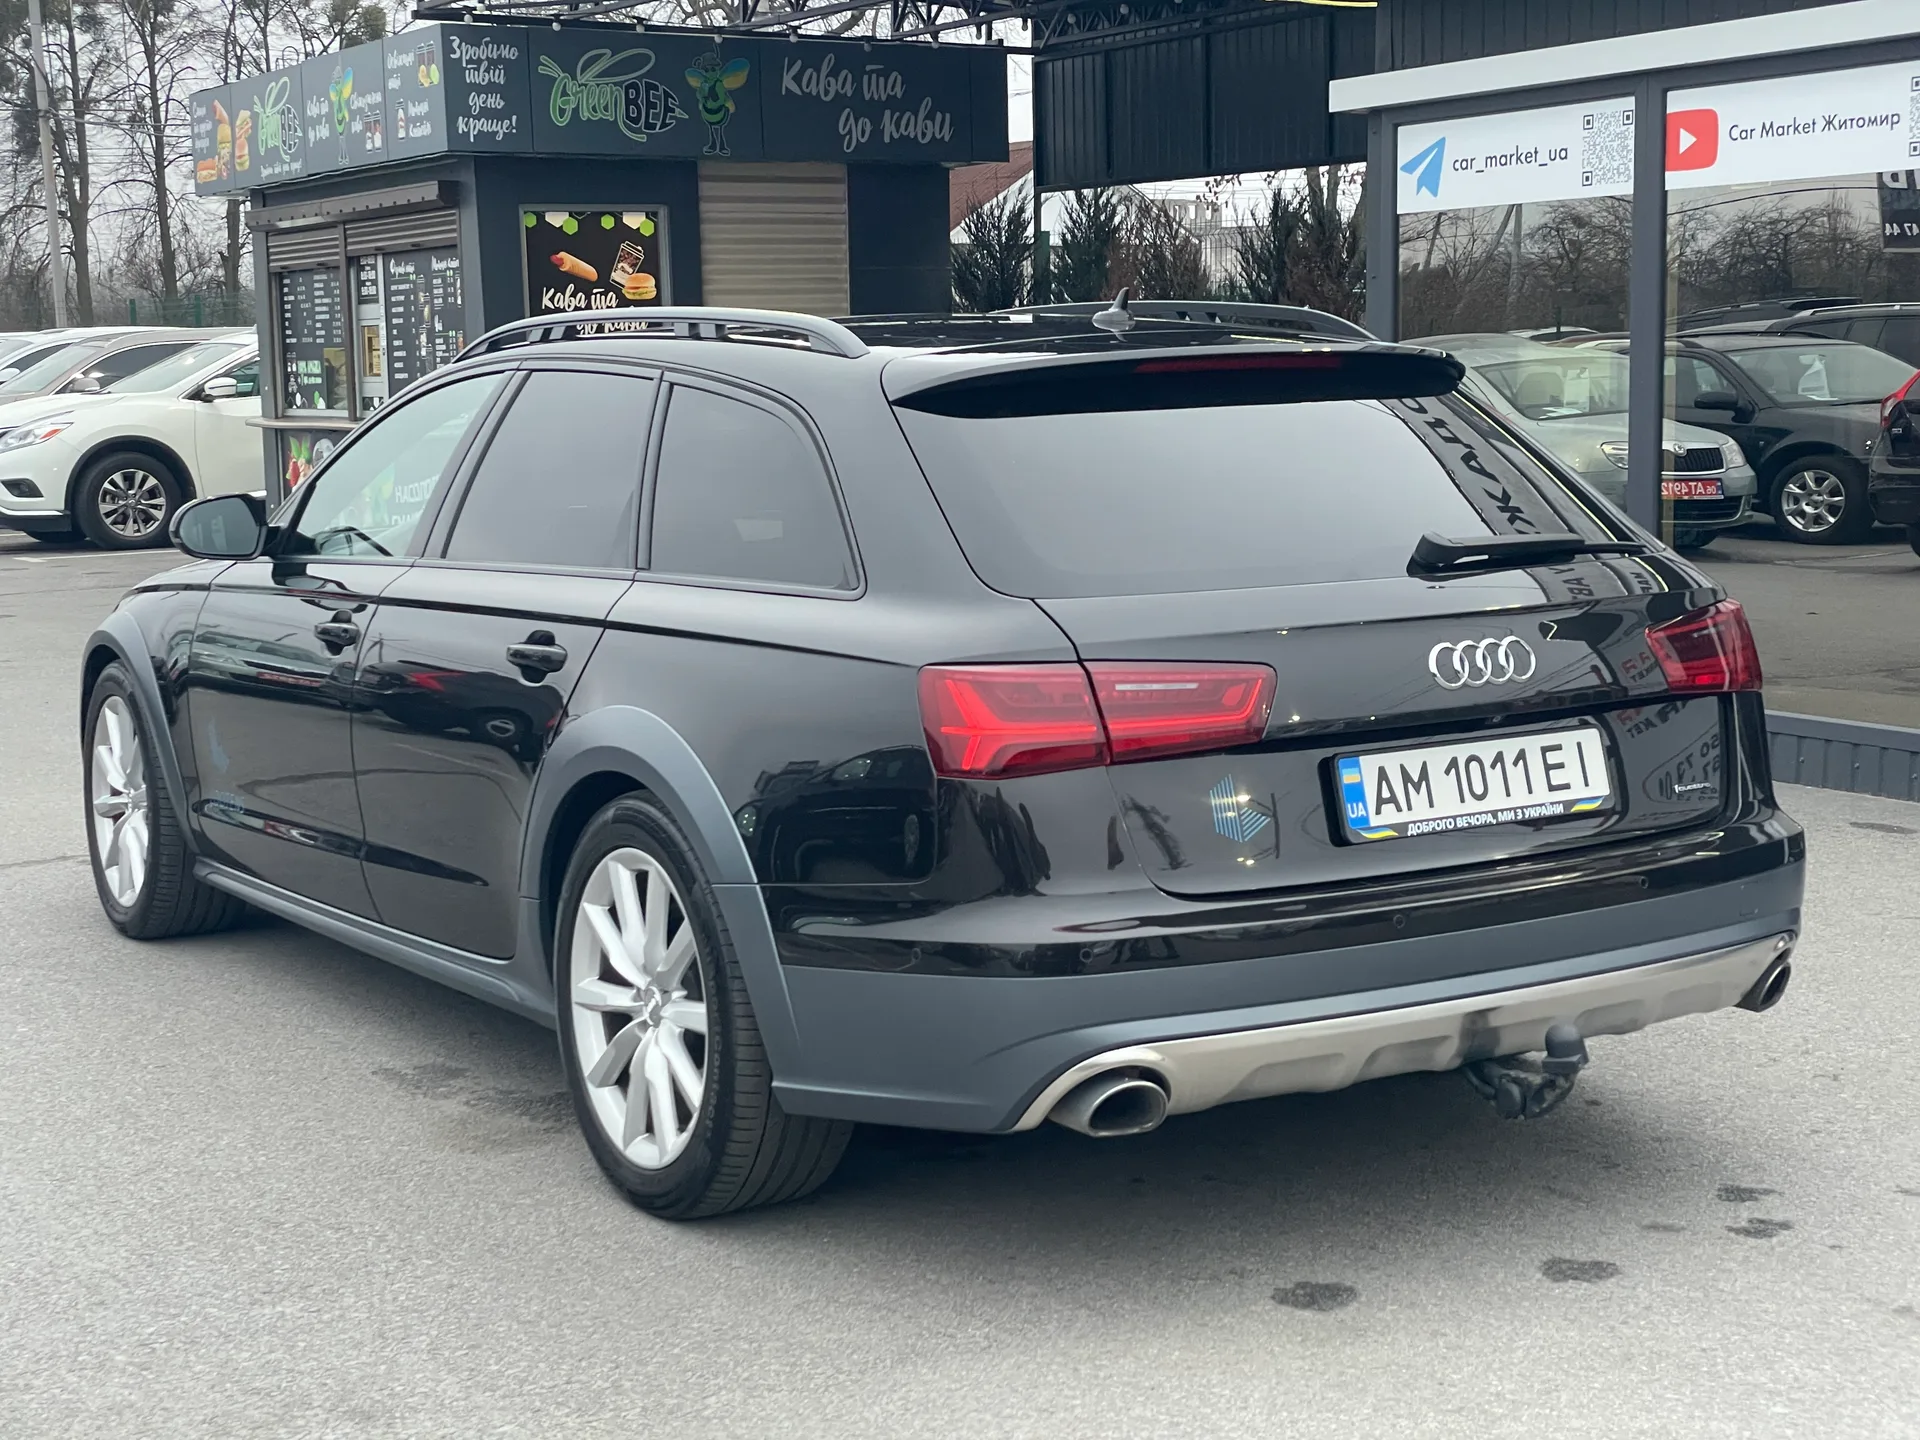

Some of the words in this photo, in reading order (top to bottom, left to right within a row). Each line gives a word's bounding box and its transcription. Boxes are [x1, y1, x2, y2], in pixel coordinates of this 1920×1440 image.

[449, 36, 519, 66] Зробимо
[465, 61, 506, 85] твій
[781, 53, 857, 102] Кава
[862, 64, 906, 101] та
[468, 92, 505, 115] день
[550, 72, 682, 141] GreenBEE
[456, 114, 518, 143] краще!
[838, 107, 873, 153] до
[880, 97, 955, 144] кави
[1728, 124, 1756, 142] Car
[1760, 116, 1817, 139] Market
[1821, 112, 1901, 132] Житомир
[1452, 145, 1569, 174] car_market_ua
[541, 283, 588, 312] Кава
[590, 288, 619, 310] та
[1374, 760, 1435, 816] AM
[1444, 748, 1534, 804] 1011
[1540, 741, 1590, 793] EI
[1347, 801, 1367, 819] UA
[1406, 818, 1455, 837] ДОБРОГО
[1456, 813, 1497, 829] ВЕЧОРА,
[1498, 809, 1515, 822] МИ
[1523, 803, 1564, 818] УКРАЇНИ
